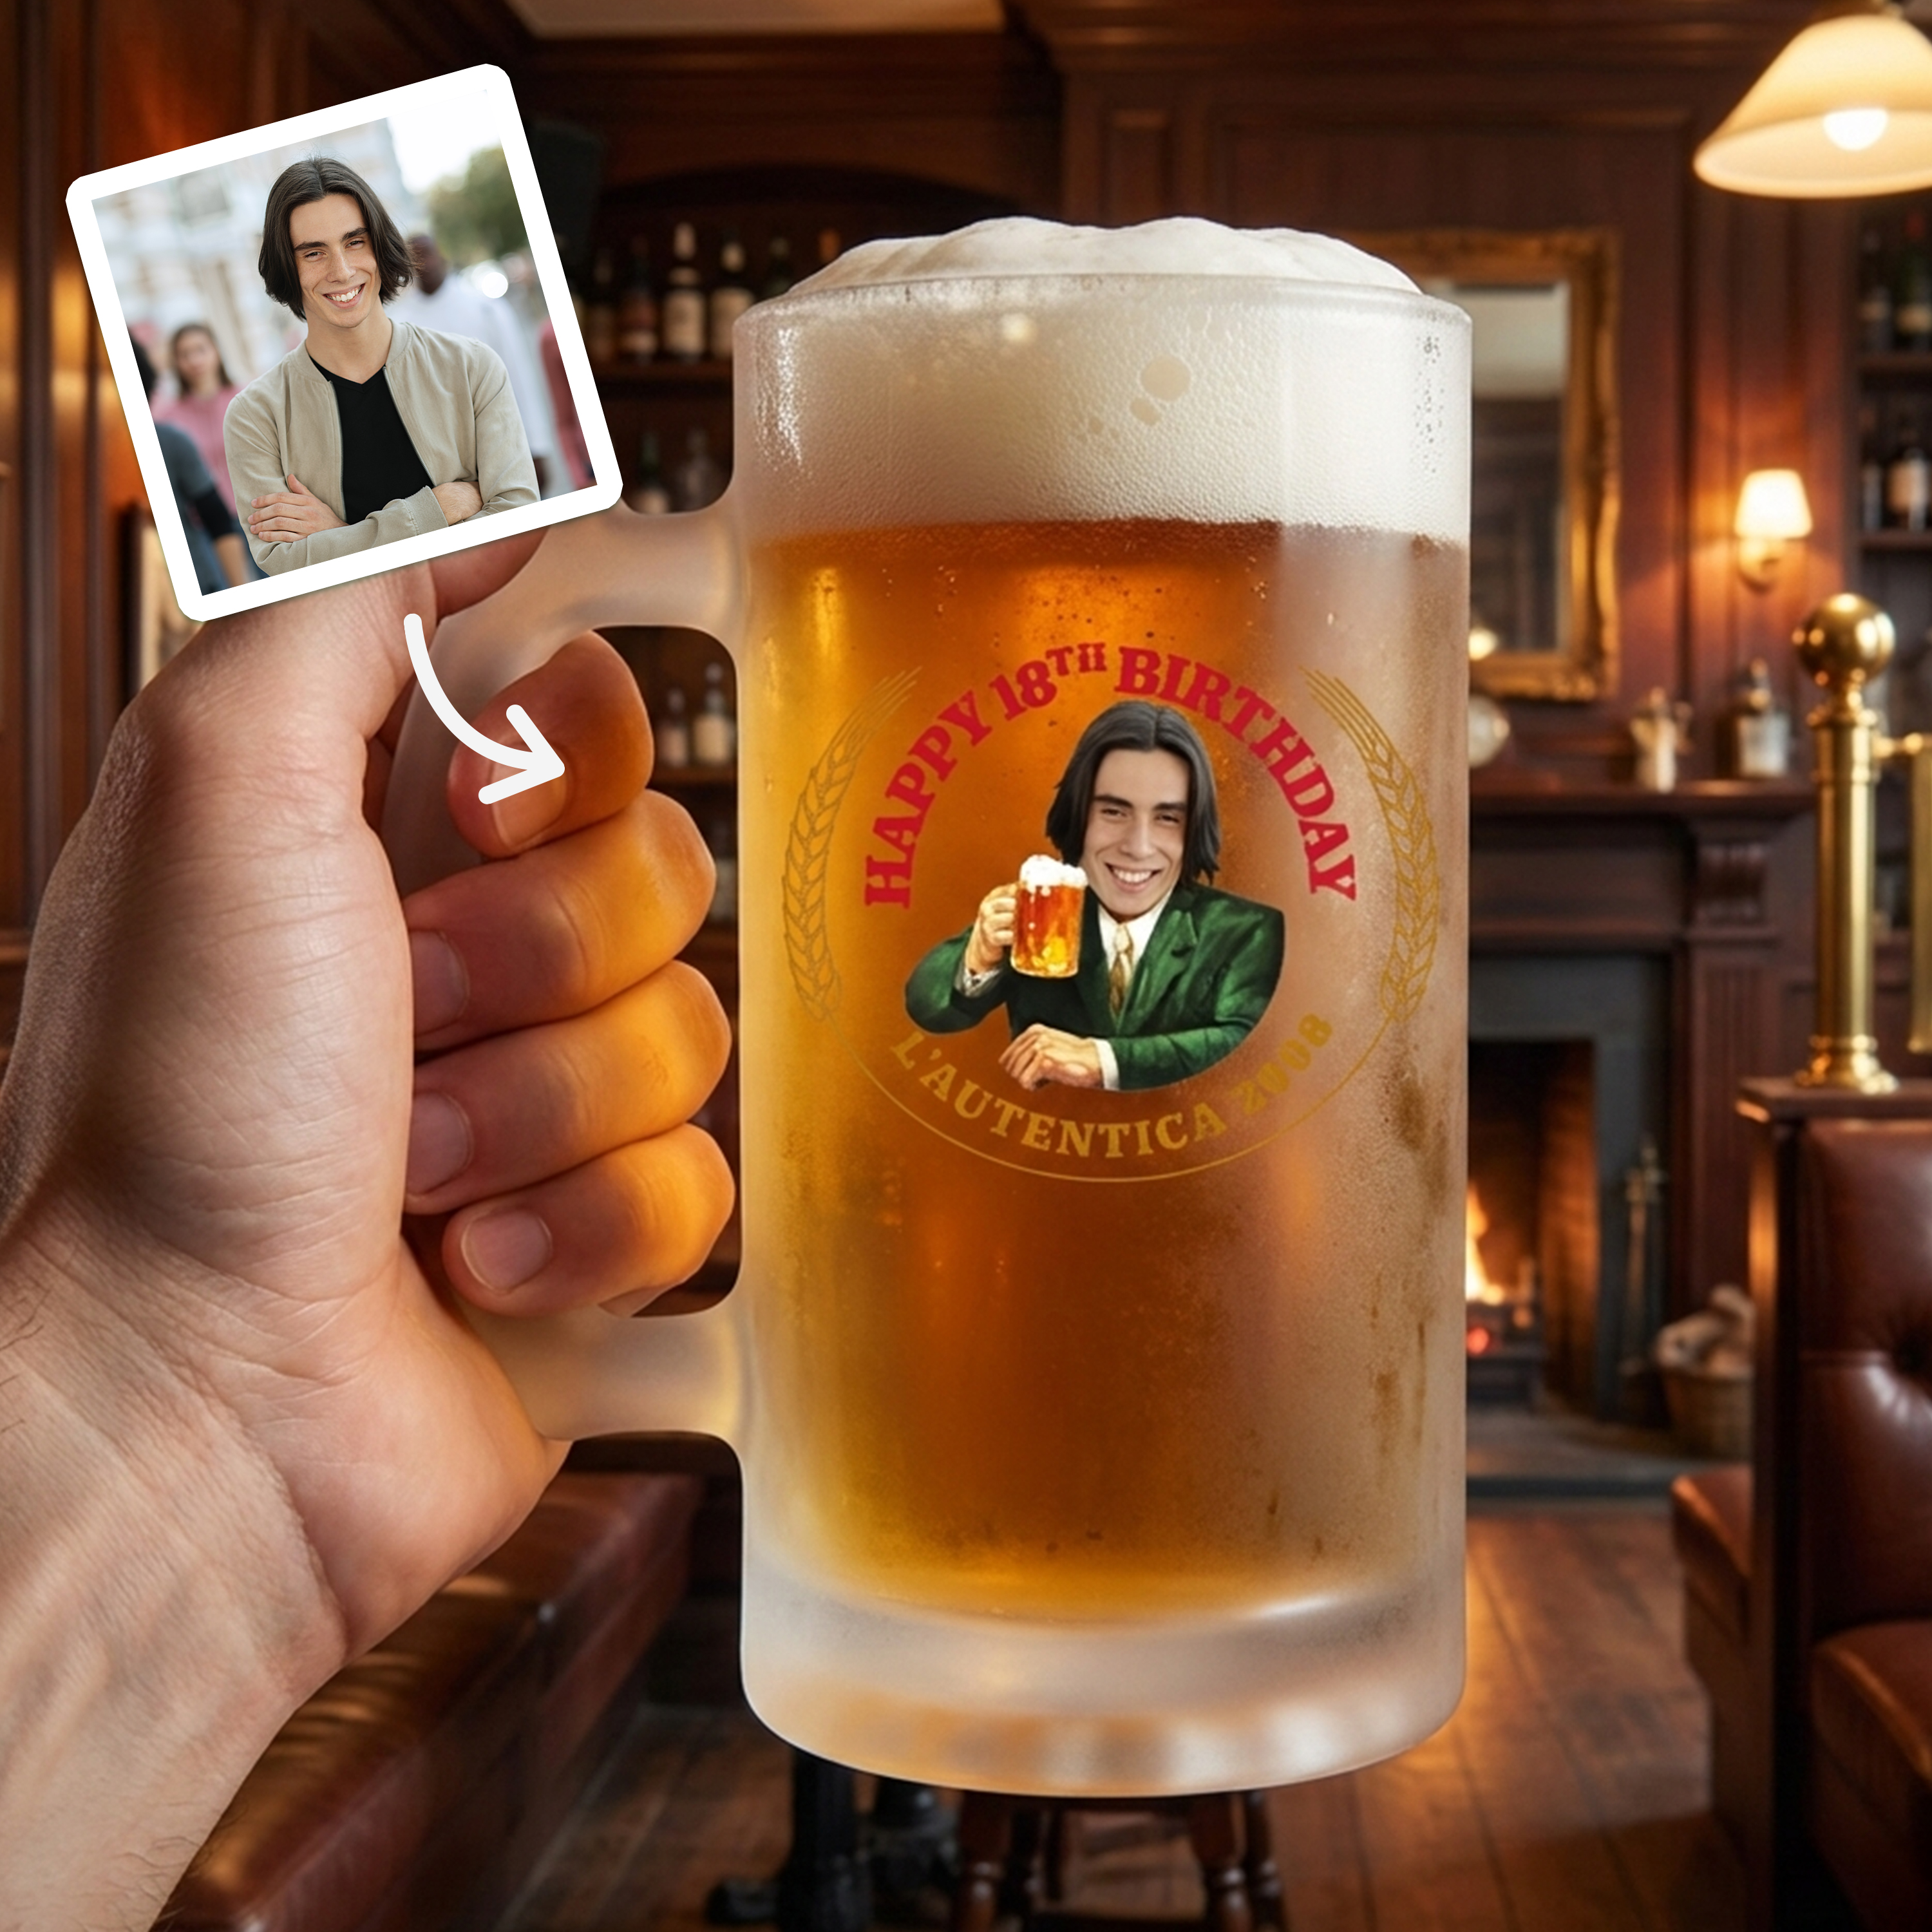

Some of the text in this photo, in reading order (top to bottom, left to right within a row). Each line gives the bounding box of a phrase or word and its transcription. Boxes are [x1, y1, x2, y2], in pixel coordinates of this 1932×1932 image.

[866, 643, 1356, 908] HAPPY 18TH BIRTHDAY
[892, 1014, 1332, 1157] L'AUTENTICA 2008
